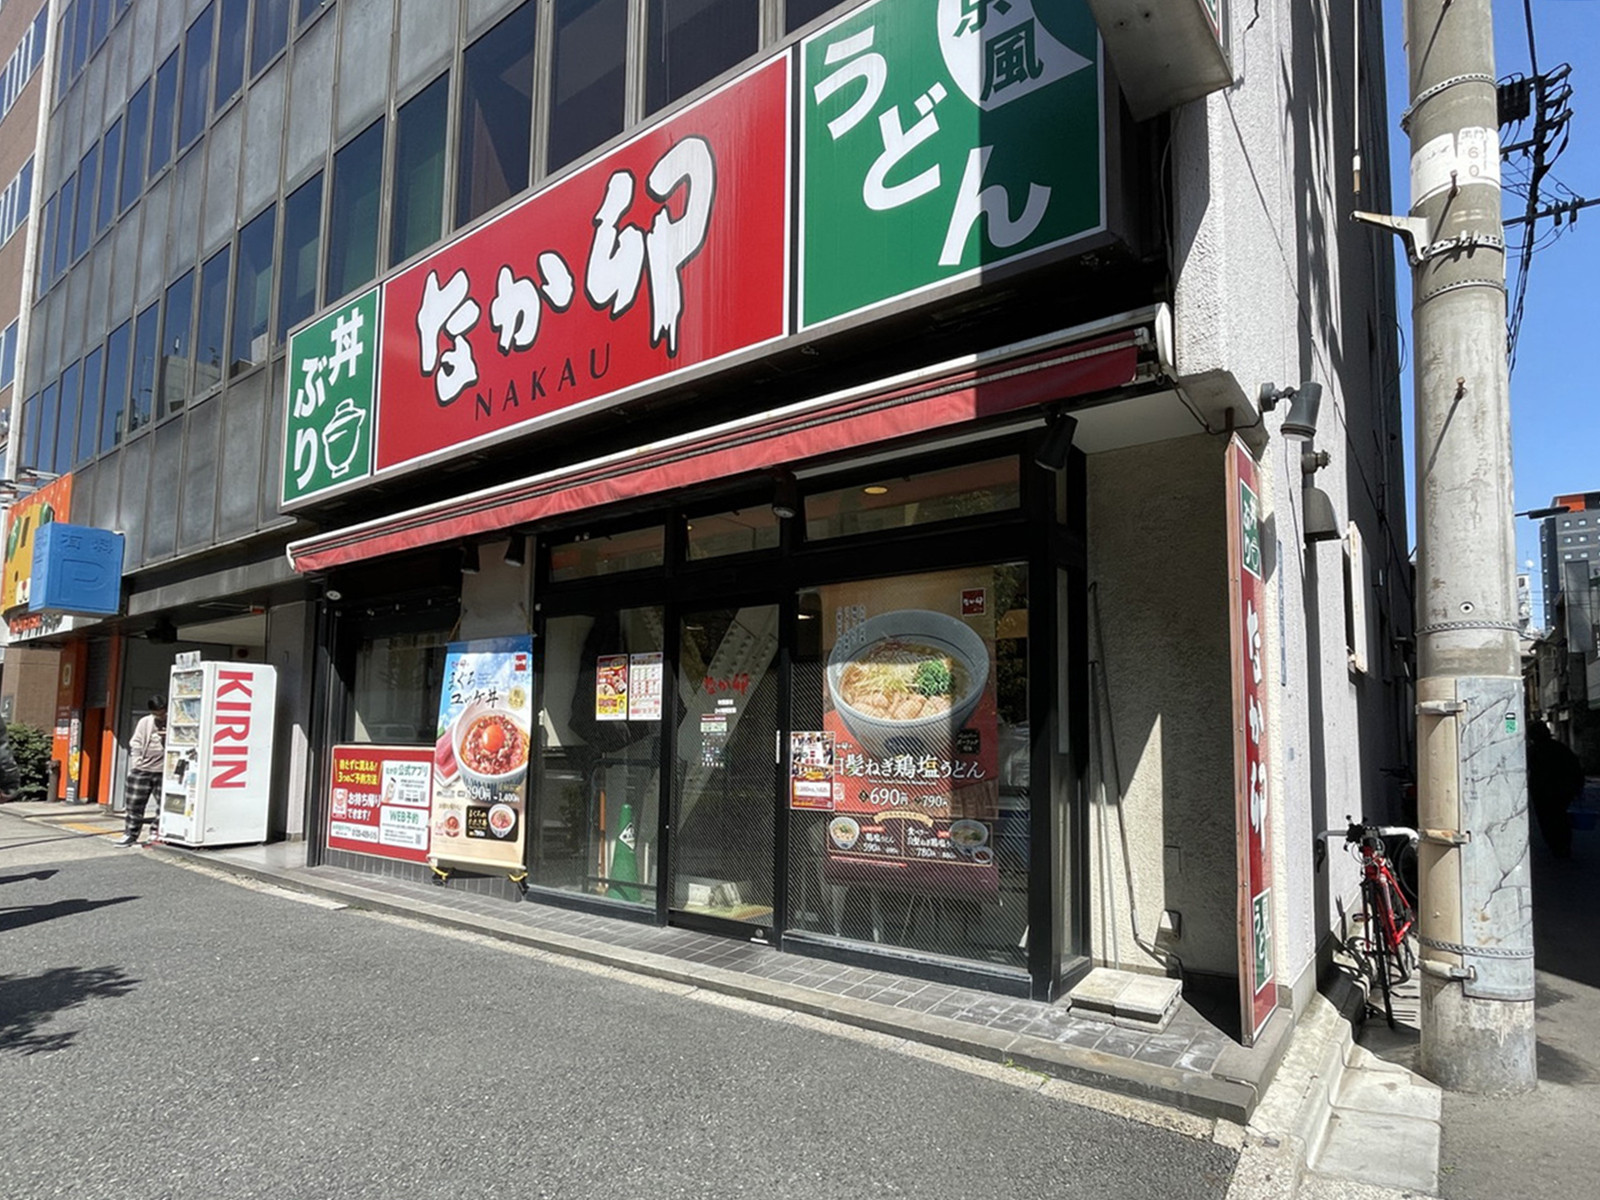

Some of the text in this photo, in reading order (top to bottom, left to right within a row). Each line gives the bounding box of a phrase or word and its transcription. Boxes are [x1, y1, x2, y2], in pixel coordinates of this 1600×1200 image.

[813, 25, 1051, 266] うどん
[416, 136, 717, 406] なか卯
[474, 342, 612, 421] NAKAU
[210, 670, 254, 789] KIRIN
